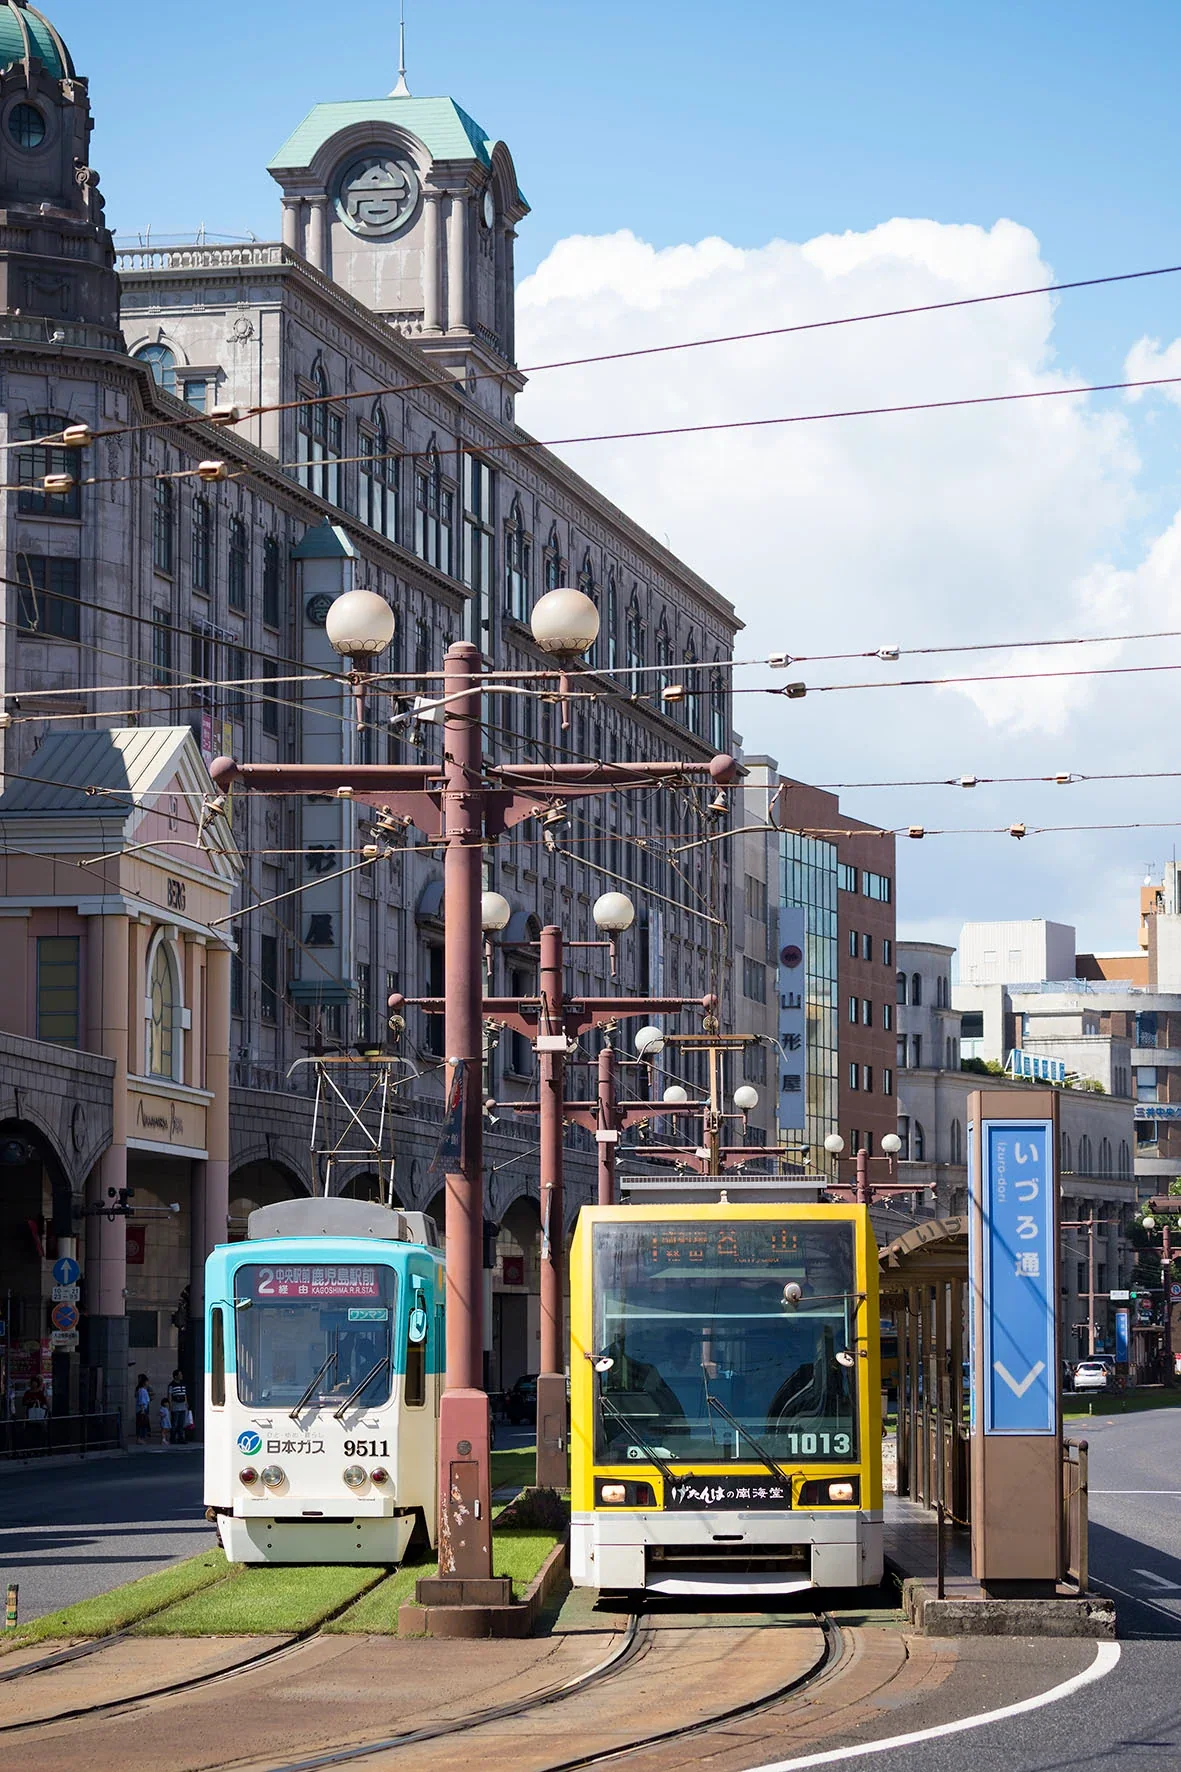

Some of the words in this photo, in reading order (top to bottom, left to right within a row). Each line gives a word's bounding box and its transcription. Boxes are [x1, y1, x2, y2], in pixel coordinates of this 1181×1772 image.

[167, 877, 186, 912] BERG
[781, 991, 802, 1093] 山形屋
[1014, 1141, 1041, 1279] いづろ通
[258, 1267, 275, 1294] 2
[276, 1268, 310, 1284] 中央駅前
[311, 1268, 375, 1286] 鹿児島駅前
[278, 1285, 308, 1294] 経由
[350, 1310, 386, 1319] ワンマン
[267, 1440, 326, 1454] 日本ガス
[344, 1440, 391, 1457] 9511
[788, 1433, 850, 1454] 1013
[671, 1484, 785, 1504] げたんはの南海堂
